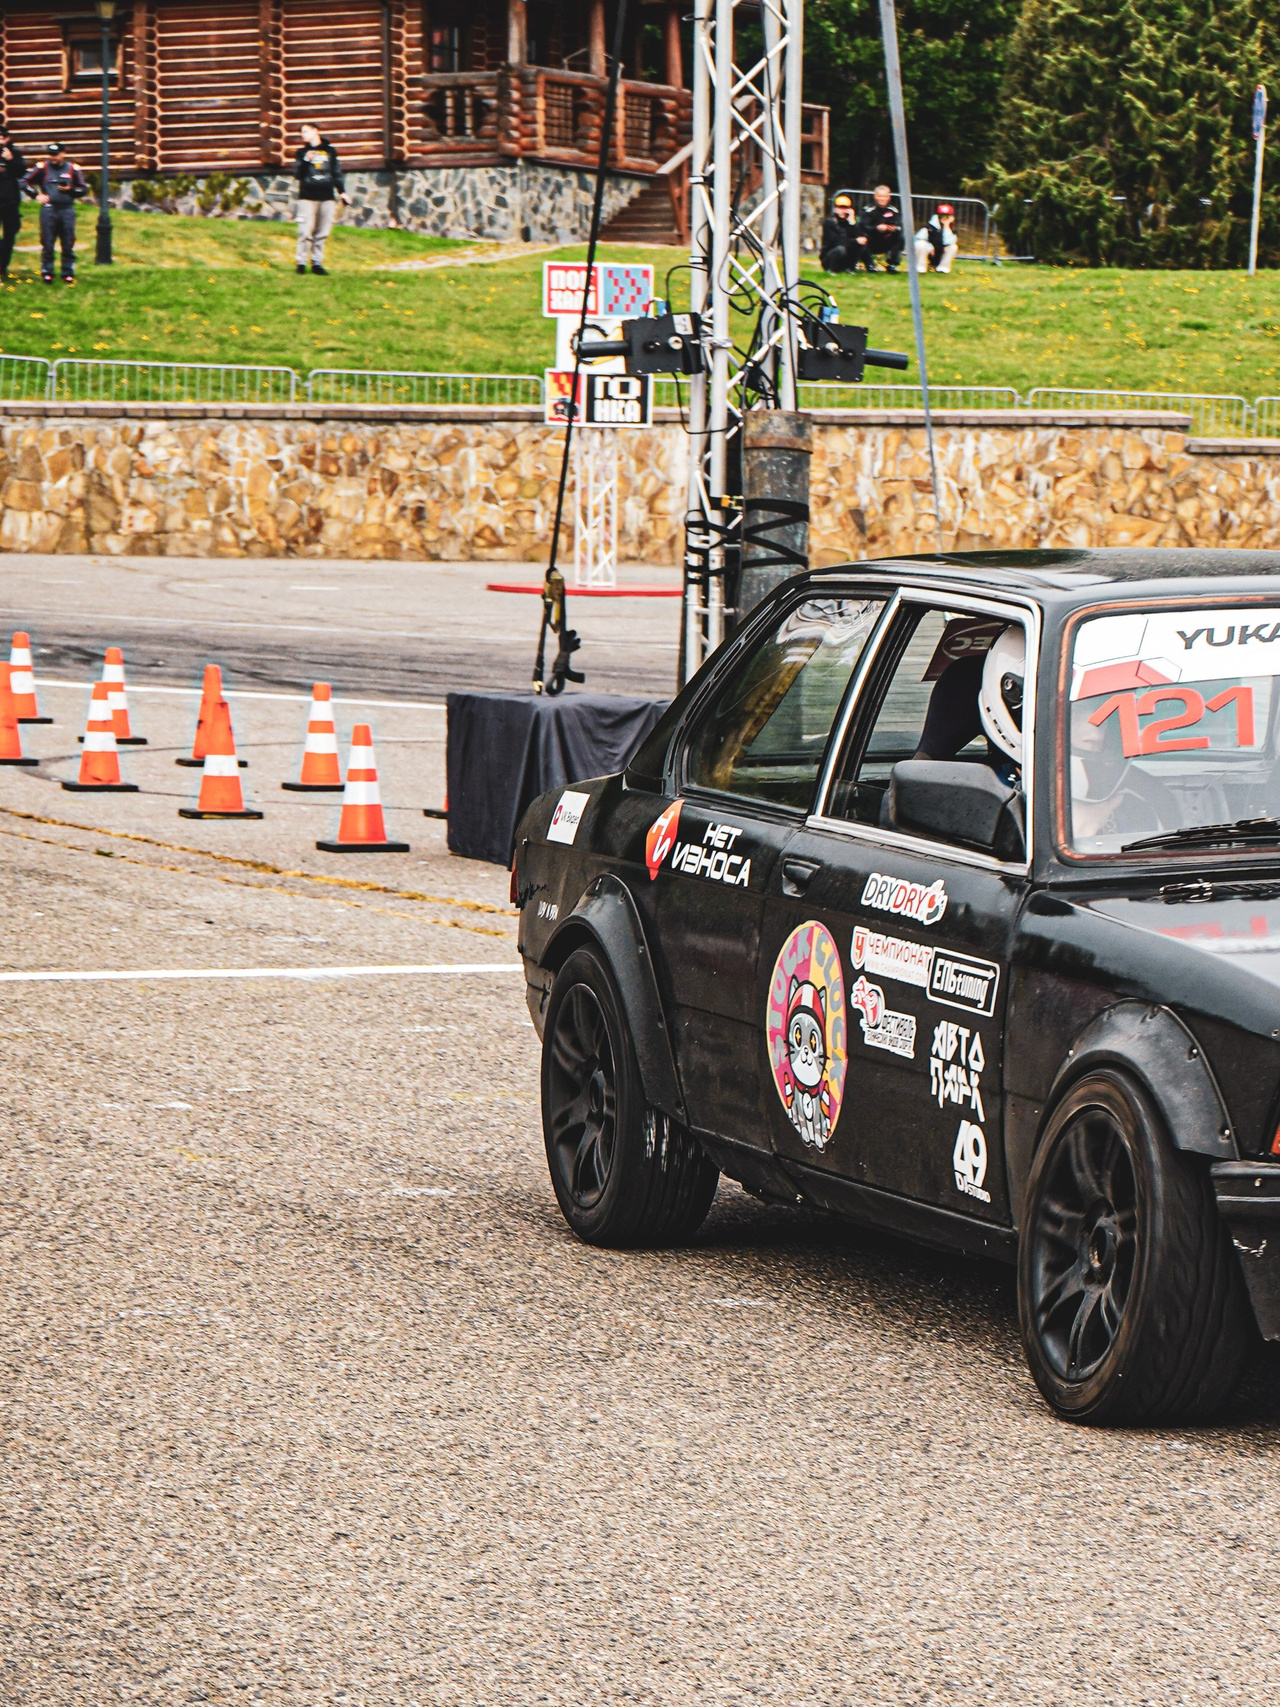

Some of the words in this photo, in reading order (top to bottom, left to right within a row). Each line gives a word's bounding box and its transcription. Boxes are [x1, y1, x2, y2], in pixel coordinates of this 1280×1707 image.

[594, 376, 641, 399] ГО
[594, 399, 641, 422] НКА
[1086, 686, 1255, 758] 121
[702, 822, 744, 850] НЕТ
[864, 877, 929, 915] DRYDRY
[868, 937, 931, 970] ЧЕМПИОНАТ
